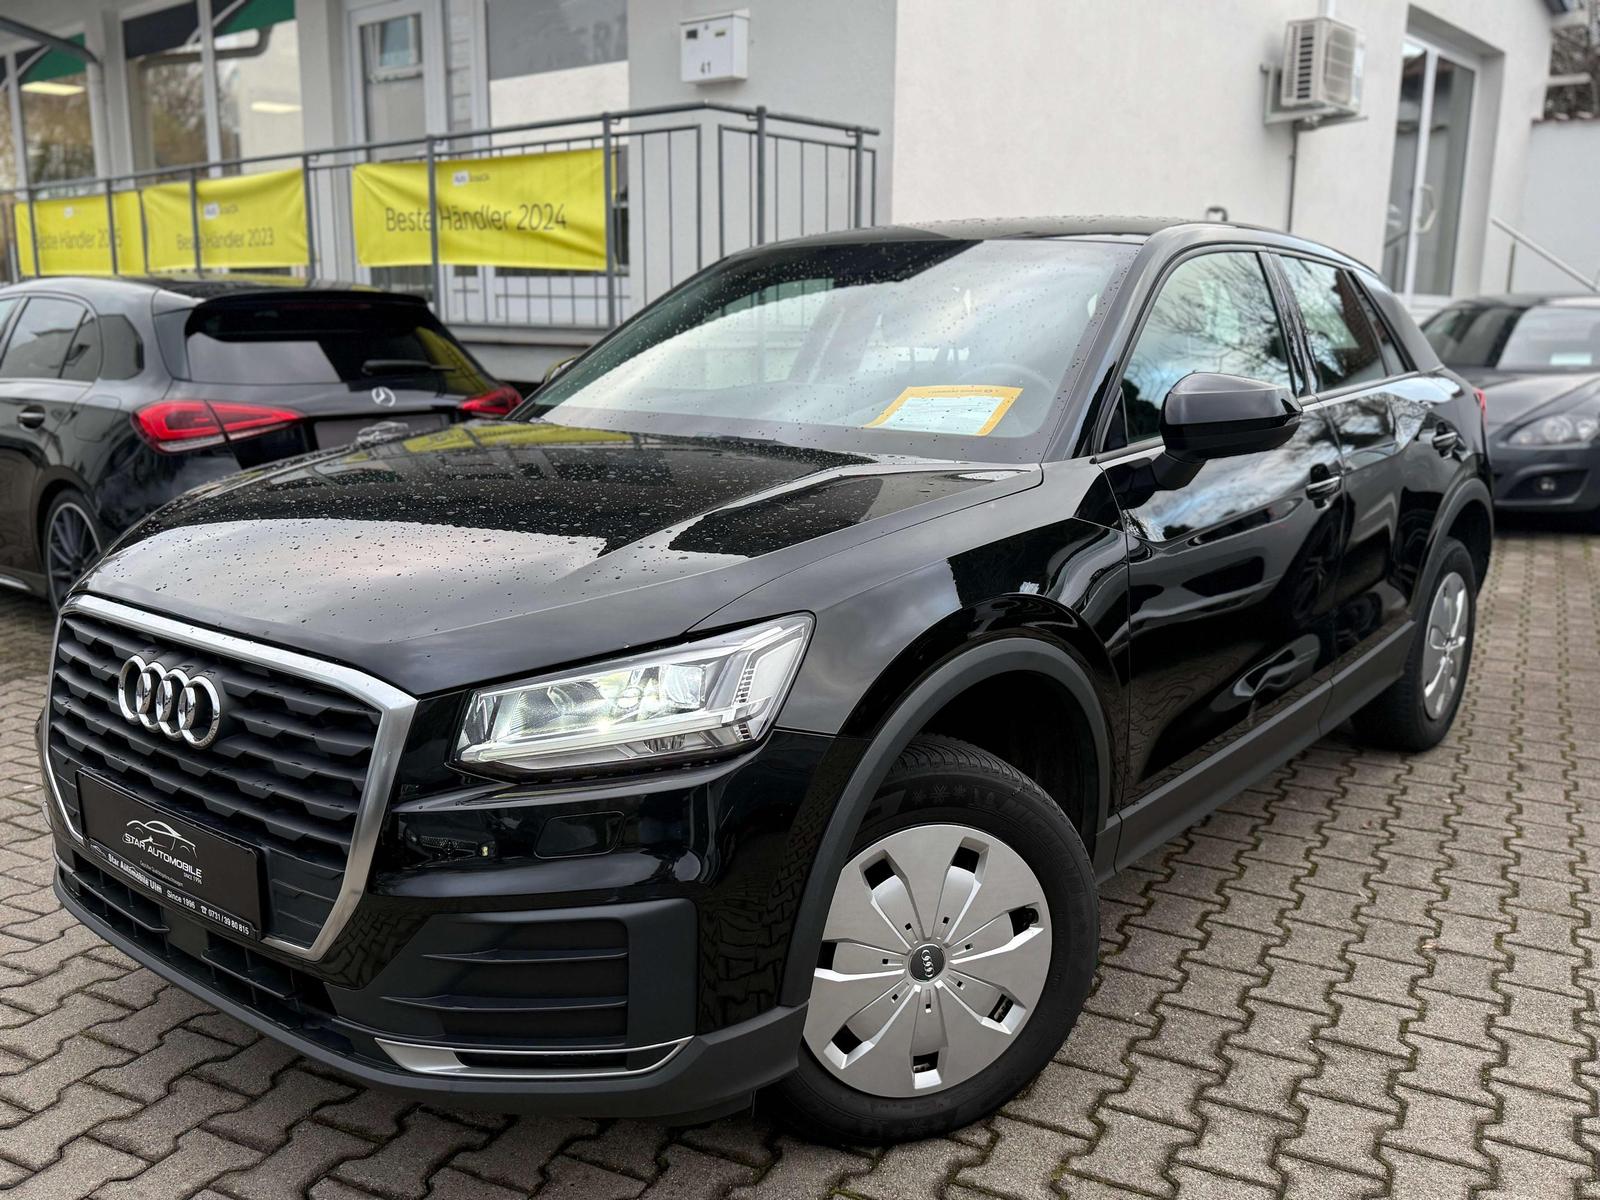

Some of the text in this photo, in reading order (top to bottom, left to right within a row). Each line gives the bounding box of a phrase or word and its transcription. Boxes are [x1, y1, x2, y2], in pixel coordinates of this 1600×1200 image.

[700, 61, 711, 74] 41
[385, 202, 567, 232] Beste Händler 2024
[124, 832, 146, 850] STAR
[147, 845, 202, 878] AUTOMOBILE
[107, 853, 120, 867] Star
[119, 860, 150, 887] Automobile
[149, 879, 163, 894] Ulm
[166, 889, 182, 903] Since
[182, 897, 196, 909] 1996
[238, 923, 250, 936] 815
